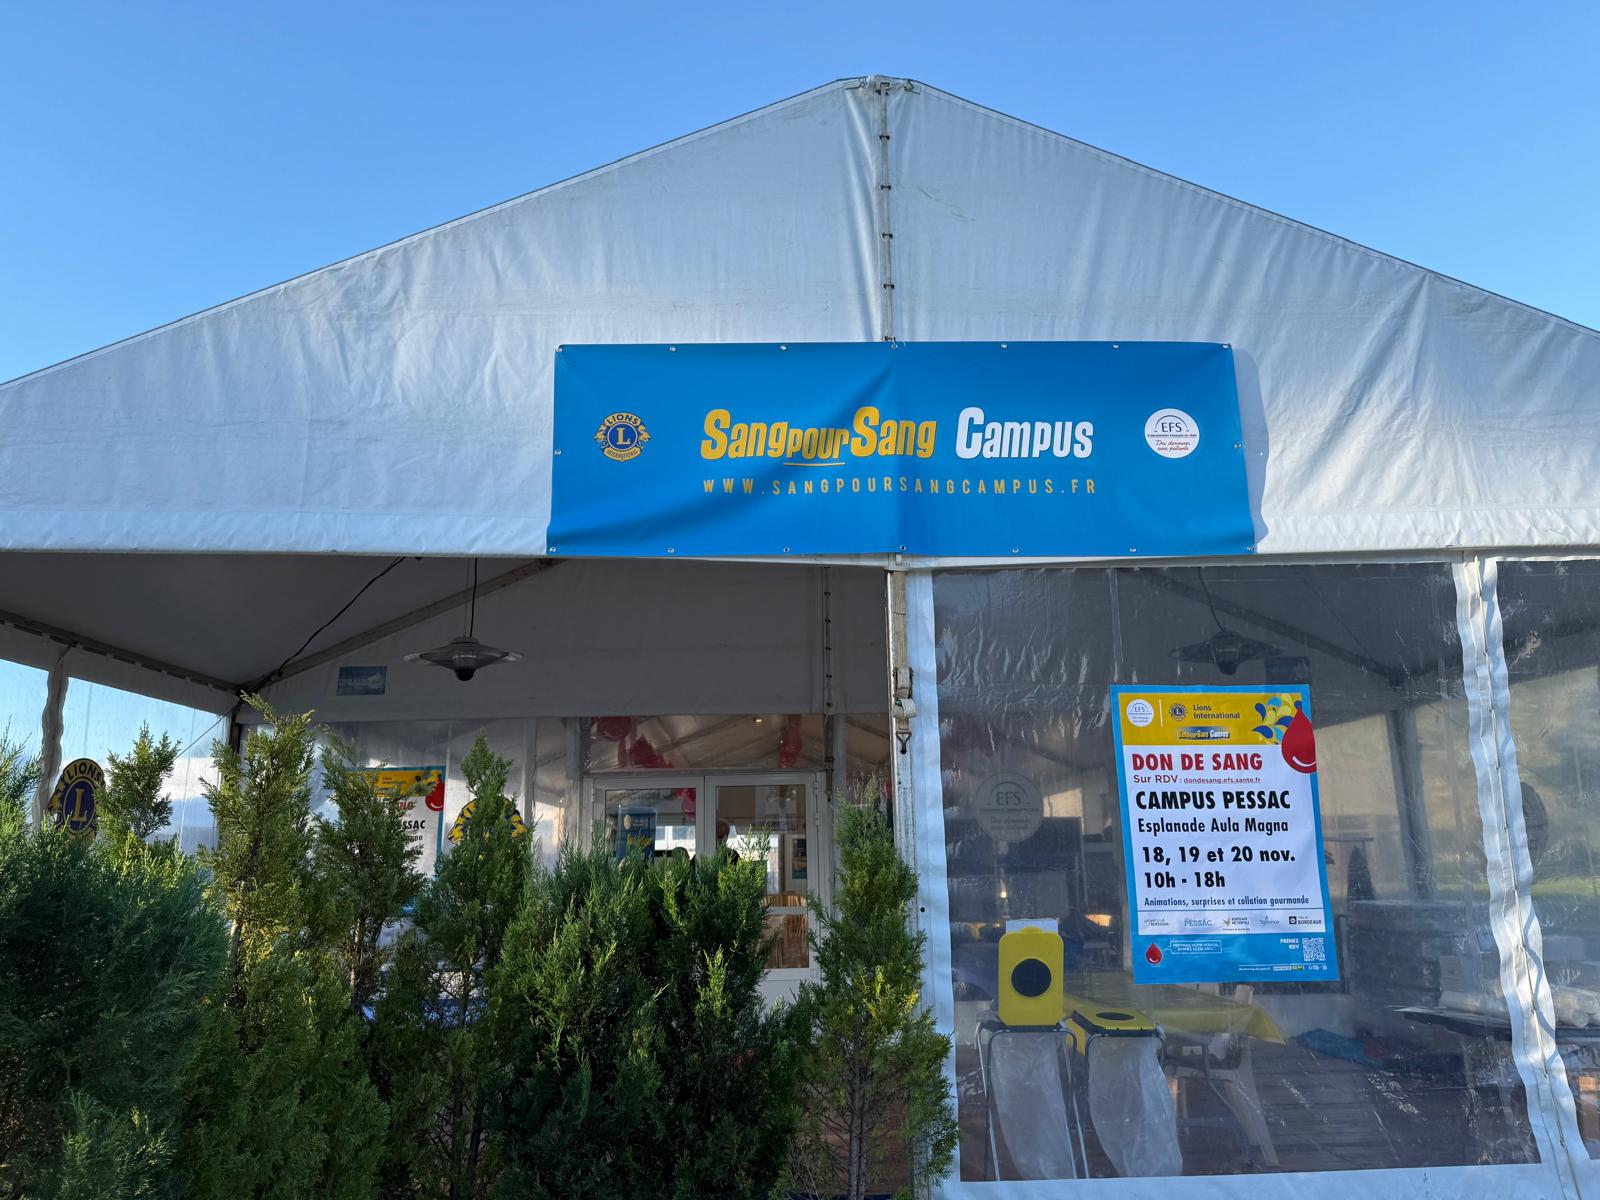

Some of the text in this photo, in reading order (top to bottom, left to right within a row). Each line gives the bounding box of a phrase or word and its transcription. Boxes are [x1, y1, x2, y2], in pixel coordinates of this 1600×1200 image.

[606, 414, 639, 425] LIONS
[1162, 422, 1182, 432] EFS
[617, 428, 630, 444] L
[956, 406, 1094, 458] Campus
[703, 476, 1095, 494] WWW.SANGPOURSANGCAMPUS.FR
[1132, 753, 1263, 770] DON DE SANG
[66, 762, 102, 782] LIONS
[1134, 775, 1151, 784] Sur
[1155, 775, 1178, 783] RDV
[72, 788, 88, 821] L
[996, 792, 1021, 806] EFS
[1136, 790, 1291, 809] CAMPUS PESSAC
[402, 820, 426, 829] SSAC
[1138, 817, 1288, 836] Esplanade Aula Magna
[1142, 846, 1296, 865] 18, 19 et 20 nov.
[1145, 872, 1175, 888] 10h
[1194, 871, 1225, 887] 18h
[1144, 895, 1309, 908] Animations, surprises et collation gourmande
